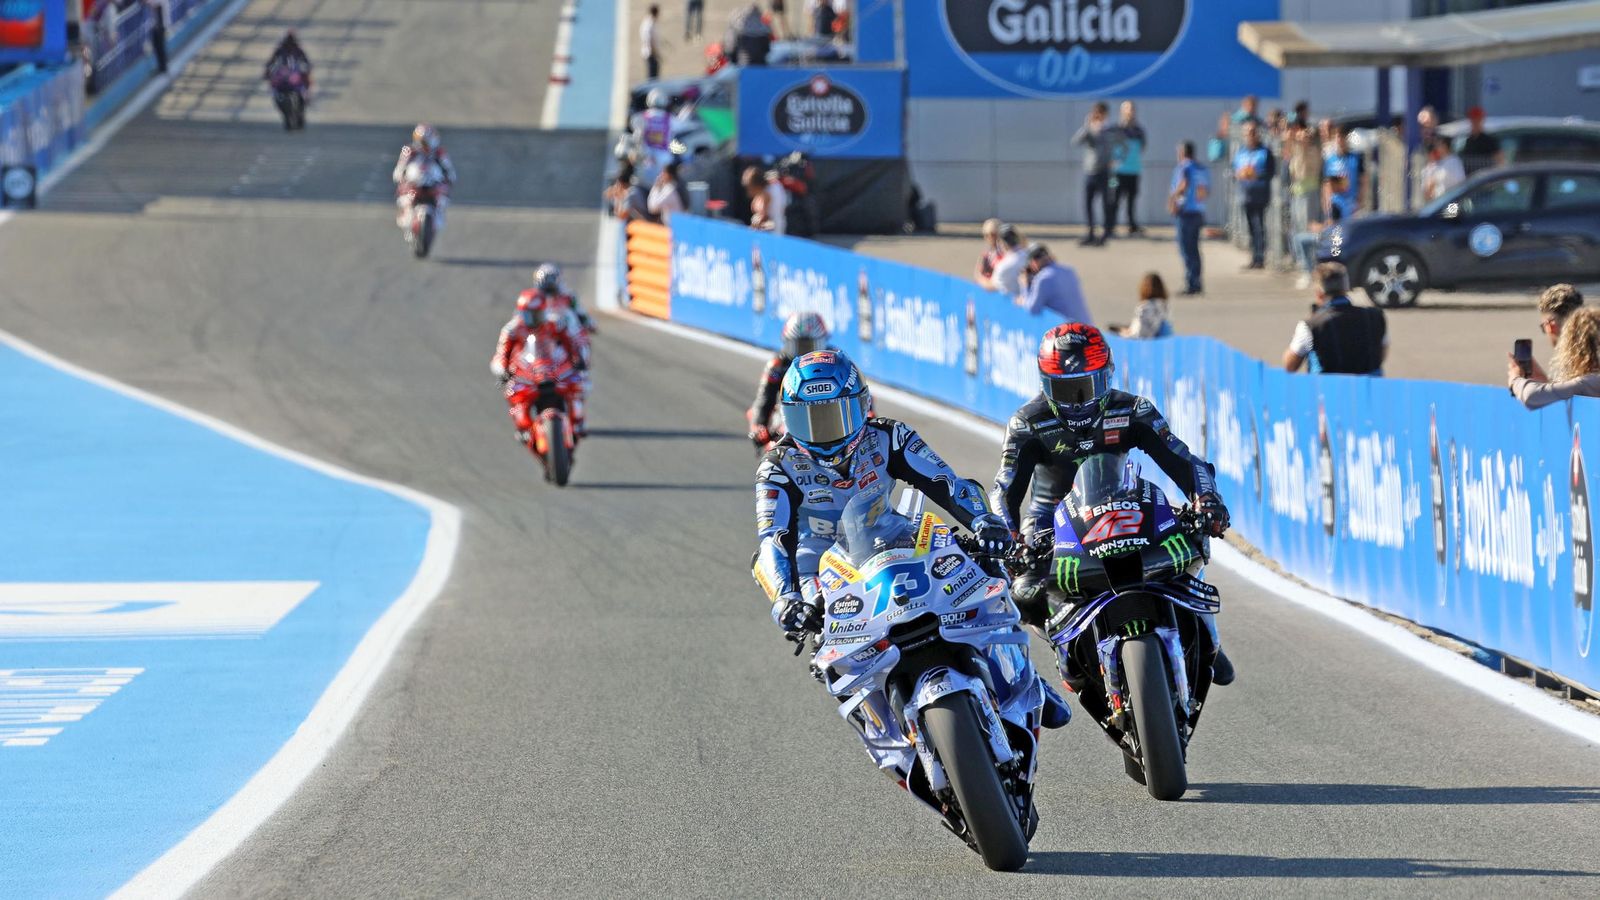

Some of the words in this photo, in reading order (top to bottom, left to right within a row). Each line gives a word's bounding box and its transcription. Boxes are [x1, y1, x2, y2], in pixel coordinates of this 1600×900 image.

[988, 0, 1140, 44] Galicia
[806, 384, 832, 394] SHOEI
[1067, 417, 1092, 427] prima
[1093, 501, 1141, 517] ENEOS
[1081, 510, 1145, 545] 42
[1089, 537, 1150, 557] MONSTER
[863, 560, 932, 619] 73
[943, 567, 977, 596] Unibat
[834, 600, 860, 608] Estrella
[940, 612, 967, 622] BOLD
[829, 621, 867, 634] Unibat
